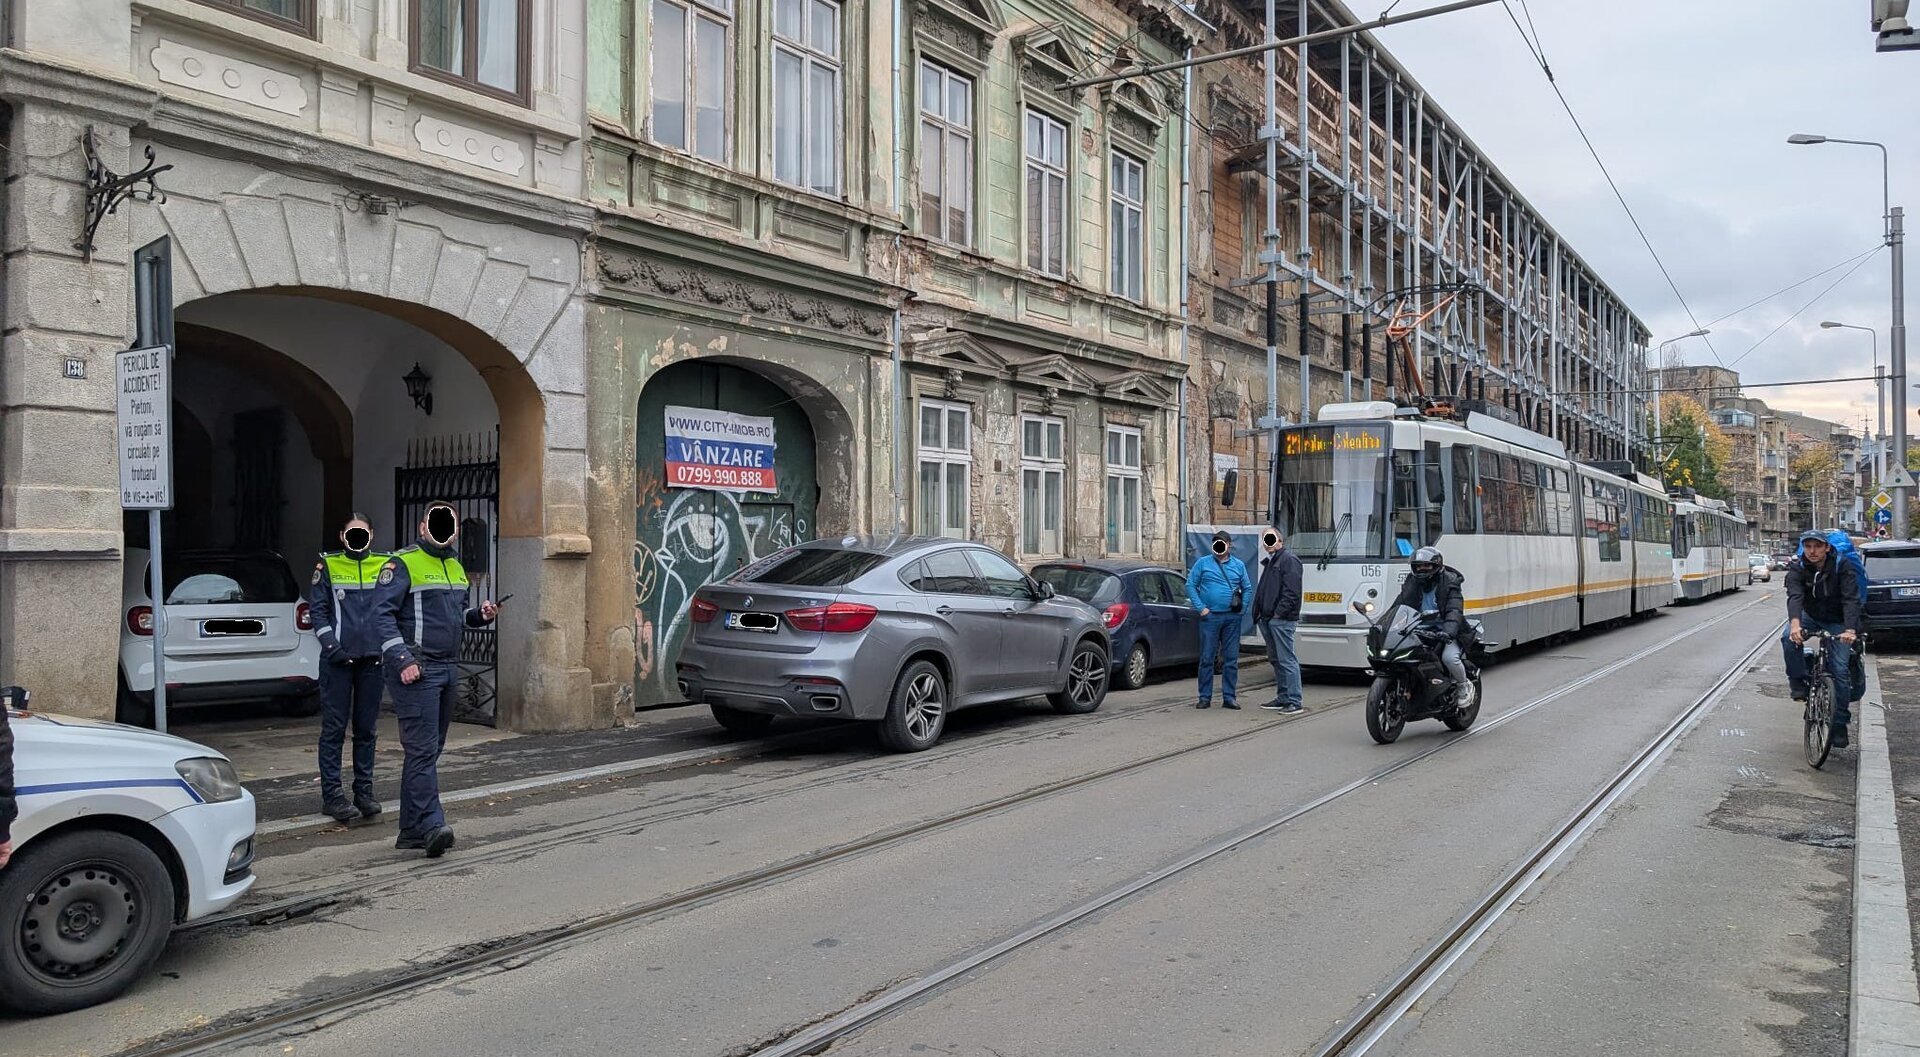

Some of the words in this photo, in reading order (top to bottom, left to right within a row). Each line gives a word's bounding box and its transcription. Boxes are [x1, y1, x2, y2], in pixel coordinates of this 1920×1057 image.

[66, 360, 84, 376] 138
[123, 355, 149, 373] PERICOL
[151, 352, 160, 369] DE
[123, 373, 161, 394] ACCIDENTE!
[130, 398, 155, 416] Pietoni,
[668, 416, 771, 438] WWW.CITY-IMOB.RO
[152, 446, 160, 461] pe
[681, 440, 764, 468] VÂNZARE
[131, 463, 157, 481] trotuarul
[677, 466, 763, 486] 0799.990.888
[123, 487, 132, 503] de
[1361, 564, 1382, 577] 056
